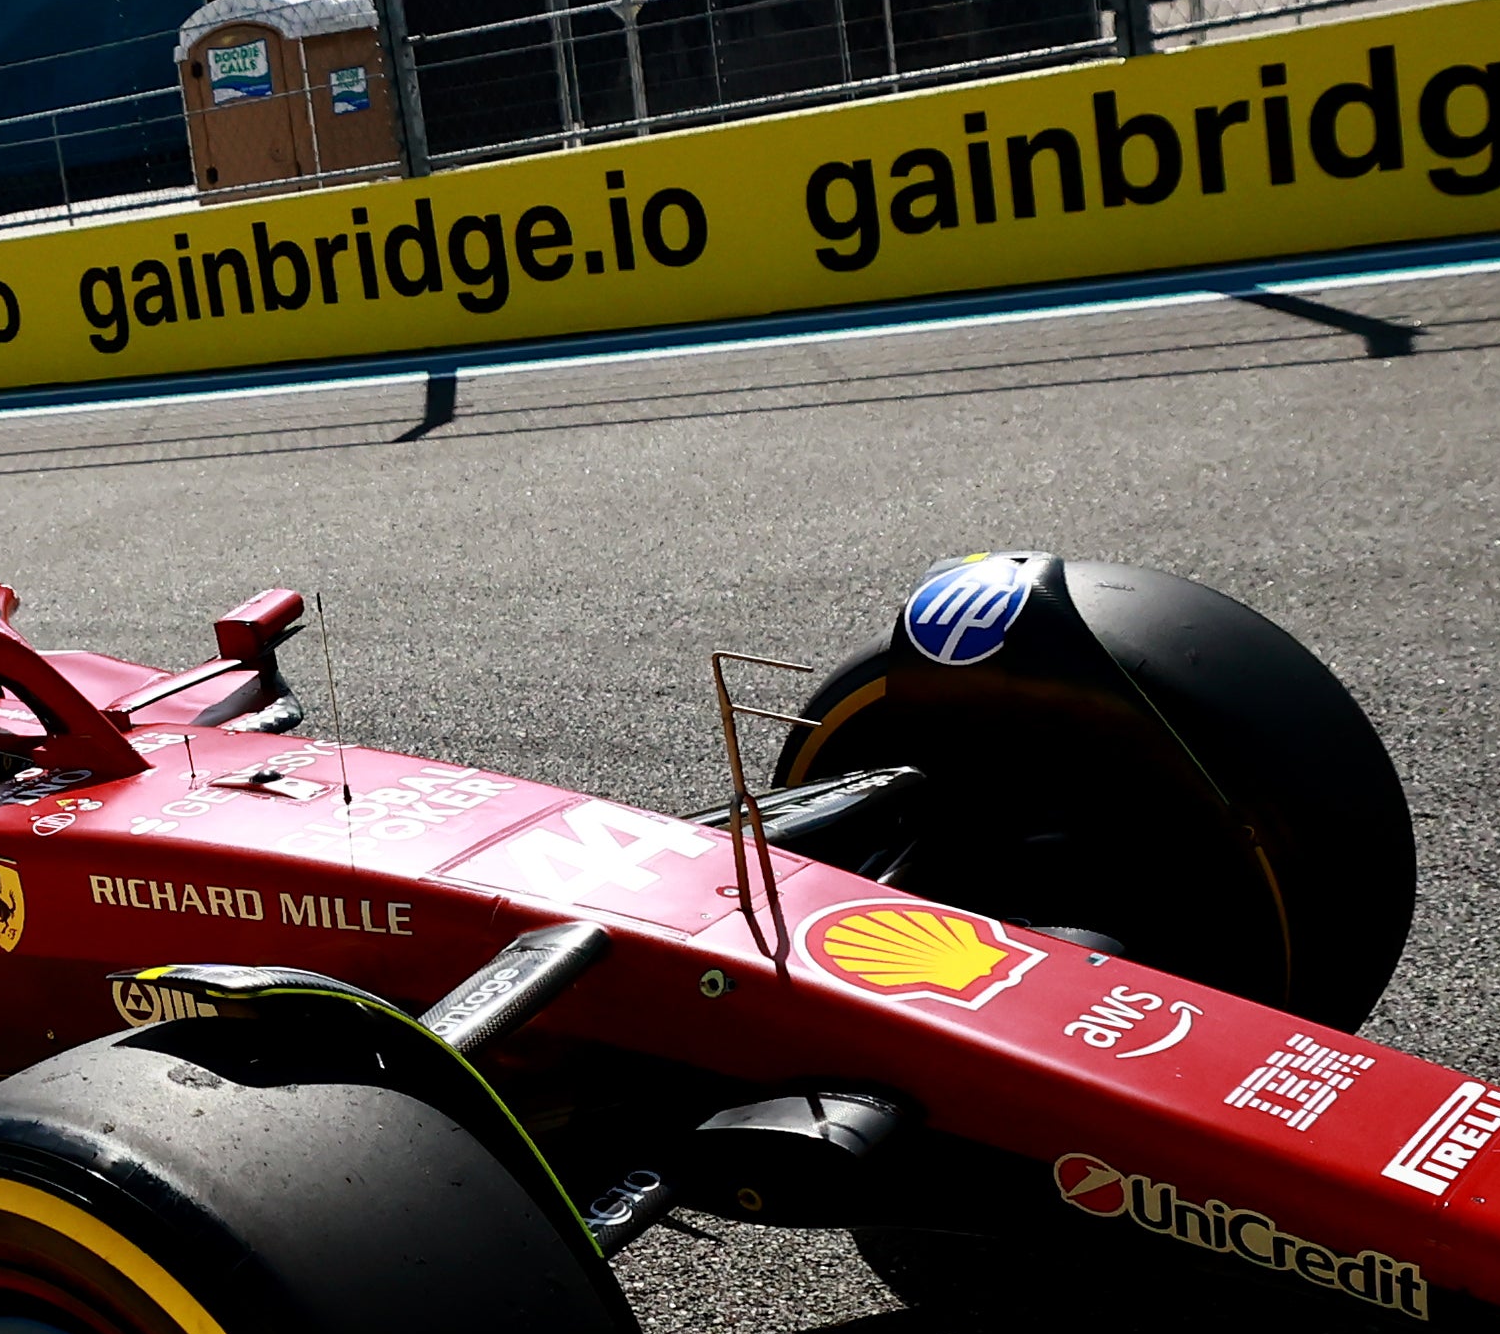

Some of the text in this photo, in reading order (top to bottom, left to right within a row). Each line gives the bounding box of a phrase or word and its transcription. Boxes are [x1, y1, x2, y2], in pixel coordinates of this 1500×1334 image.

[214, 46, 260, 64] DOODIE
[220, 59, 257, 74] CALLS
[79, 169, 708, 354] gainbridge.io
[912, 564, 1030, 665] hp
[162, 738, 359, 818] GENSYS
[276, 766, 480, 853] GLOBAL
[347, 775, 518, 857] POKER
[504, 798, 718, 906] 44
[89, 874, 415, 937] RICHARD MILLE
[1064, 984, 1165, 1050] aws
[1223, 1032, 1376, 1132] IBM
[1128, 1175, 1428, 1320] UniCredit
